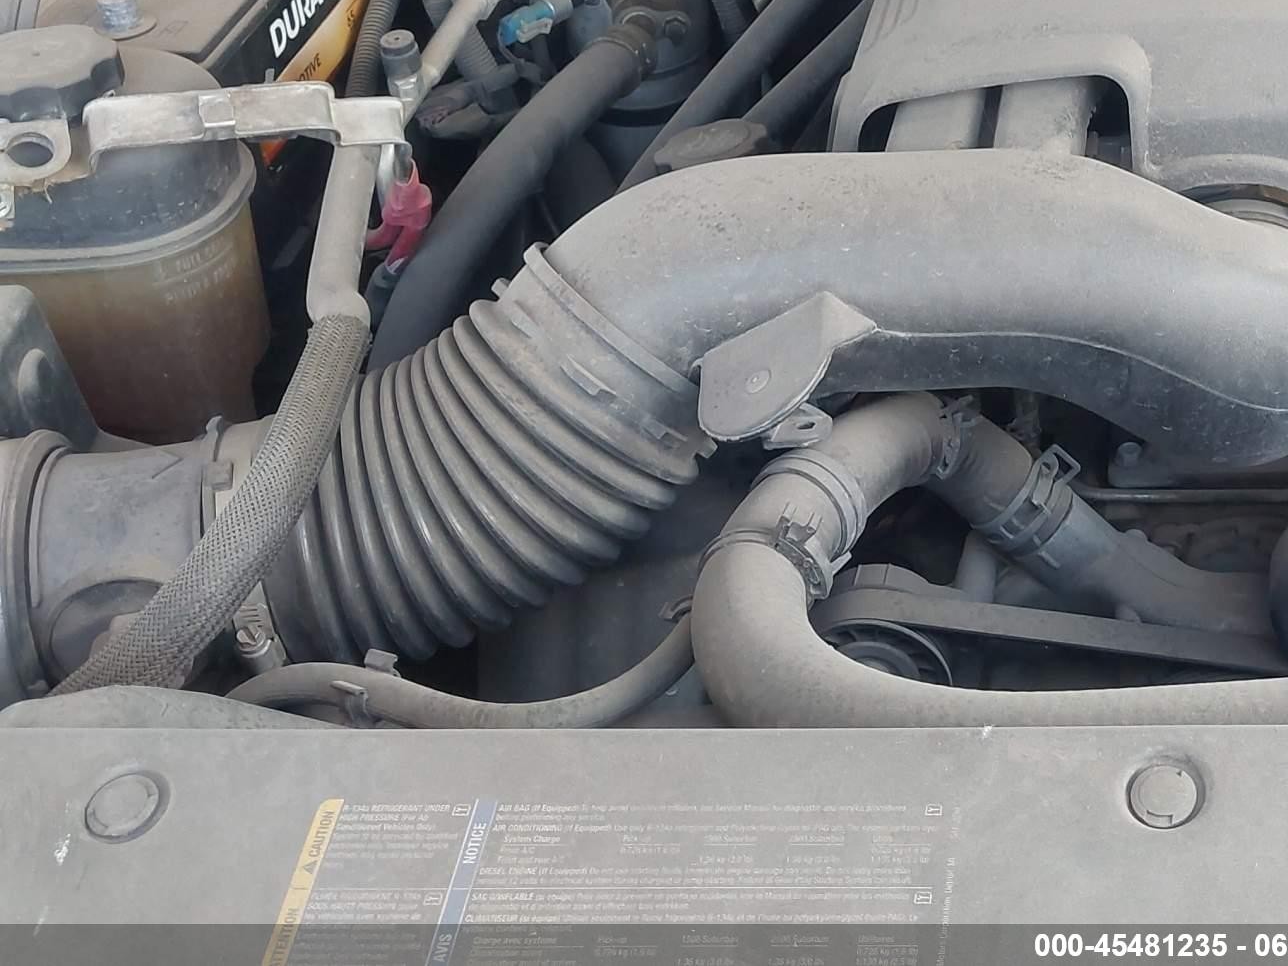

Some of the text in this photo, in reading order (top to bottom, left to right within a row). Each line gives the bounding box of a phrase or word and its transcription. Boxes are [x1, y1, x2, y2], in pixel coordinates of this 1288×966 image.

[308, 811, 334, 858] CAUTION
[463, 822, 488, 865] NOTICE
[431, 933, 453, 964] AVIS
